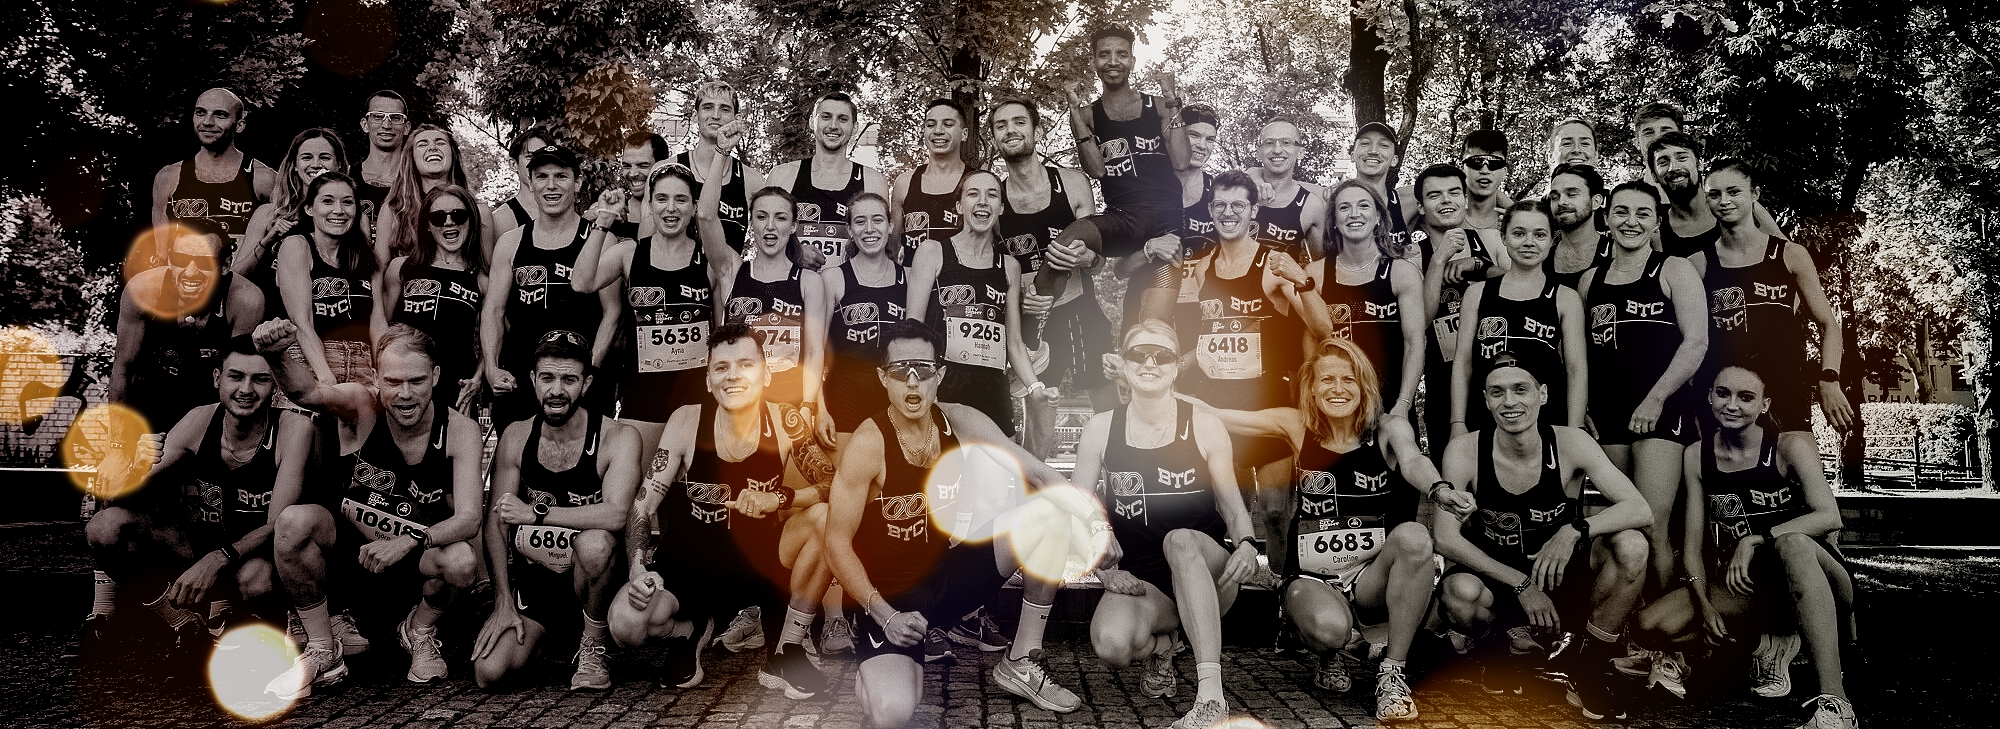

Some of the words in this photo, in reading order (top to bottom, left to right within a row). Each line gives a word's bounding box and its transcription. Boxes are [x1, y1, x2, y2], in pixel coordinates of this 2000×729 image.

[1134, 136, 1160, 151] BTC
[1105, 159, 1131, 176] BTC
[219, 197, 252, 214] BTC
[718, 201, 745, 219] BTC
[943, 210, 958, 226] BT
[1188, 218, 1214, 234] BTC
[1266, 222, 1297, 240] BTC
[1388, 231, 1405, 243] TC
[554, 263, 573, 281] BT
[449, 281, 478, 303] BTC
[519, 287, 544, 304] BTC
[680, 284, 708, 301] BTC
[1753, 281, 1788, 300] BTC
[314, 299, 348, 317] BTC
[403, 299, 434, 313] BTC
[772, 297, 802, 316] BTC
[887, 301, 906, 320] BT
[1230, 296, 1262, 313] BTC
[1364, 300, 1397, 318] BTC
[1625, 299, 1664, 317] BTC
[651, 326, 702, 346] 5638
[846, 326, 878, 343] BTC
[959, 322, 1000, 342] 9265
[1523, 316, 1555, 338] BTC
[1208, 337, 1248, 353] 6418
[746, 475, 779, 492] BTC
[1157, 467, 1195, 488] BTC
[1354, 470, 1388, 491] BTC
[237, 488, 272, 507] BTC
[567, 490, 602, 505] BTC
[1302, 495, 1334, 515] BTC
[1749, 486, 1791, 508] BTC
[691, 502, 727, 524] BTC
[1115, 499, 1142, 520] BTC
[1529, 502, 1566, 522] BTC
[887, 519, 924, 541] BTC
[1483, 526, 1519, 545] BTC
[1314, 532, 1375, 553] 6683
[1332, 554, 1359, 563] Caroline
